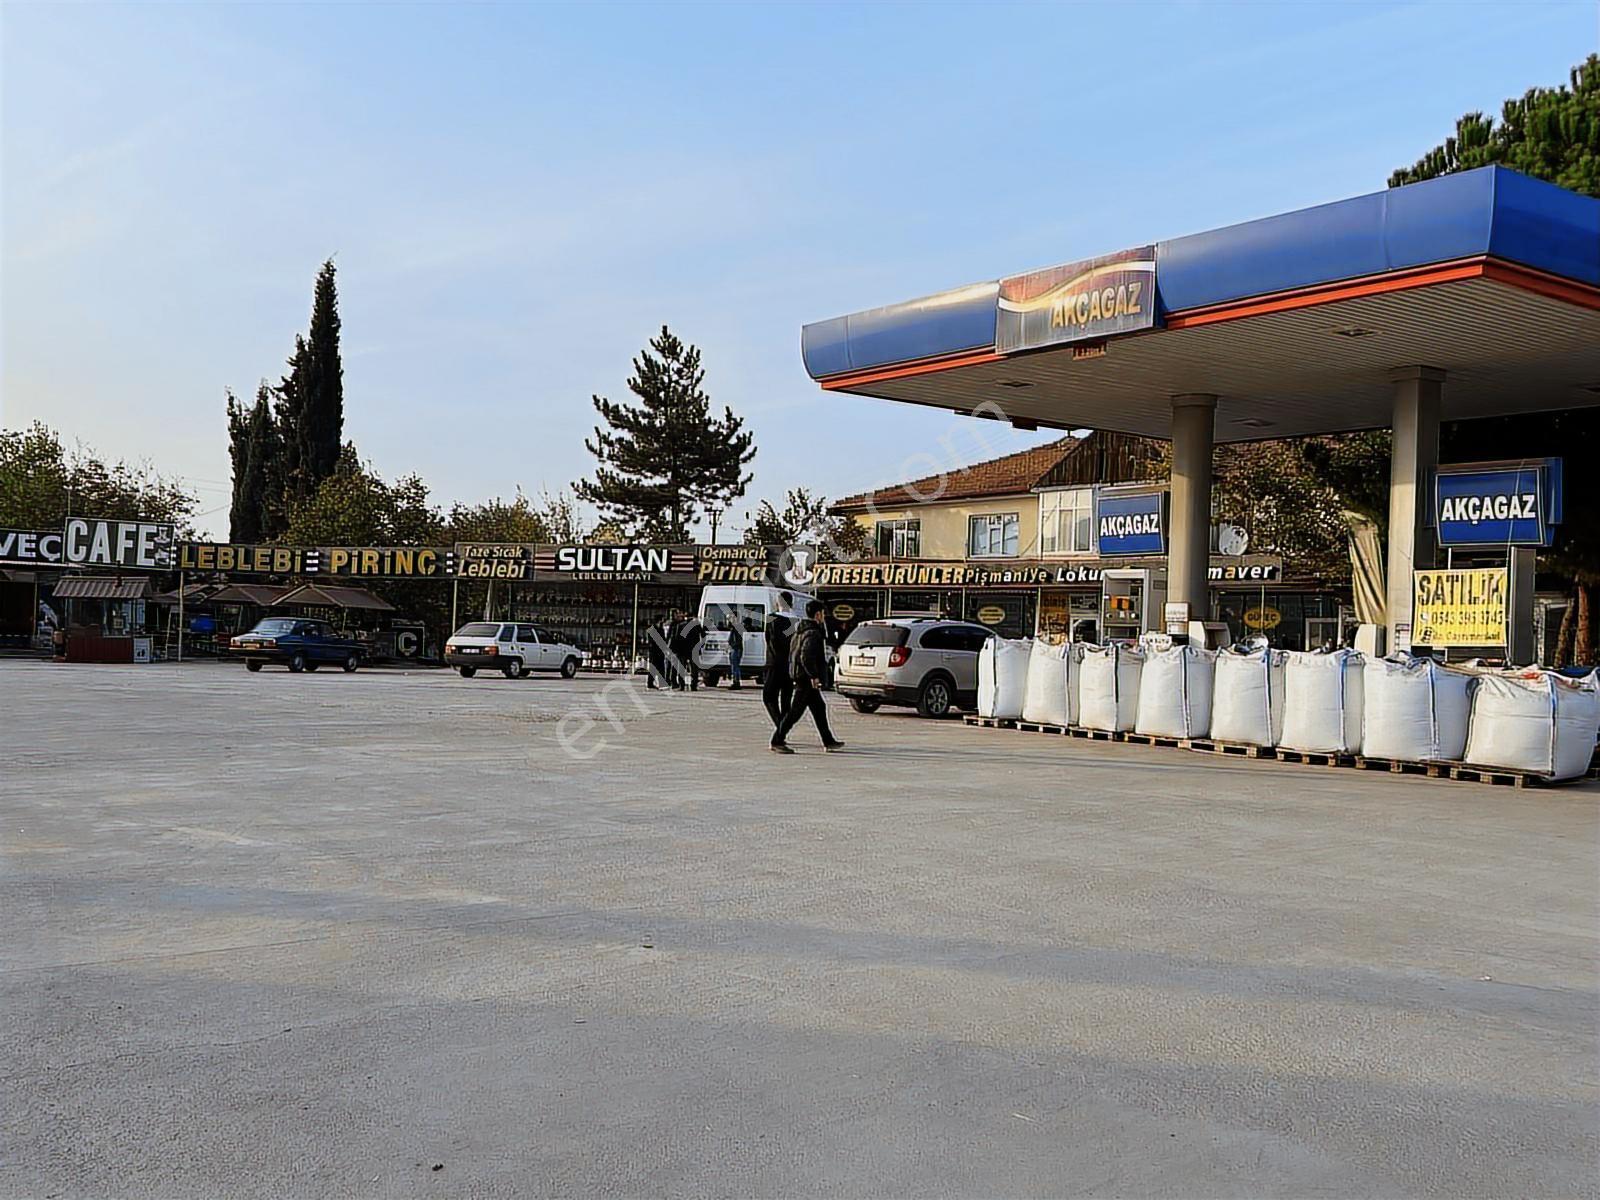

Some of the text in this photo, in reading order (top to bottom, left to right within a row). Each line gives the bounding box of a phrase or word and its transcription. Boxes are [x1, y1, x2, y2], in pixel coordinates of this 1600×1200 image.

[1052, 282, 1142, 329] AKÇAGAZ
[1441, 495, 1536, 524] AKÇAGAZ
[1100, 513, 1159, 539] AKÇAGAZ
[67, 520, 157, 566] CAFE
[458, 559, 526, 578] Leblebi
[559, 548, 668, 572] SULTAN
[698, 561, 768, 581] Pirinci
[1057, 566, 1104, 582] Loku
